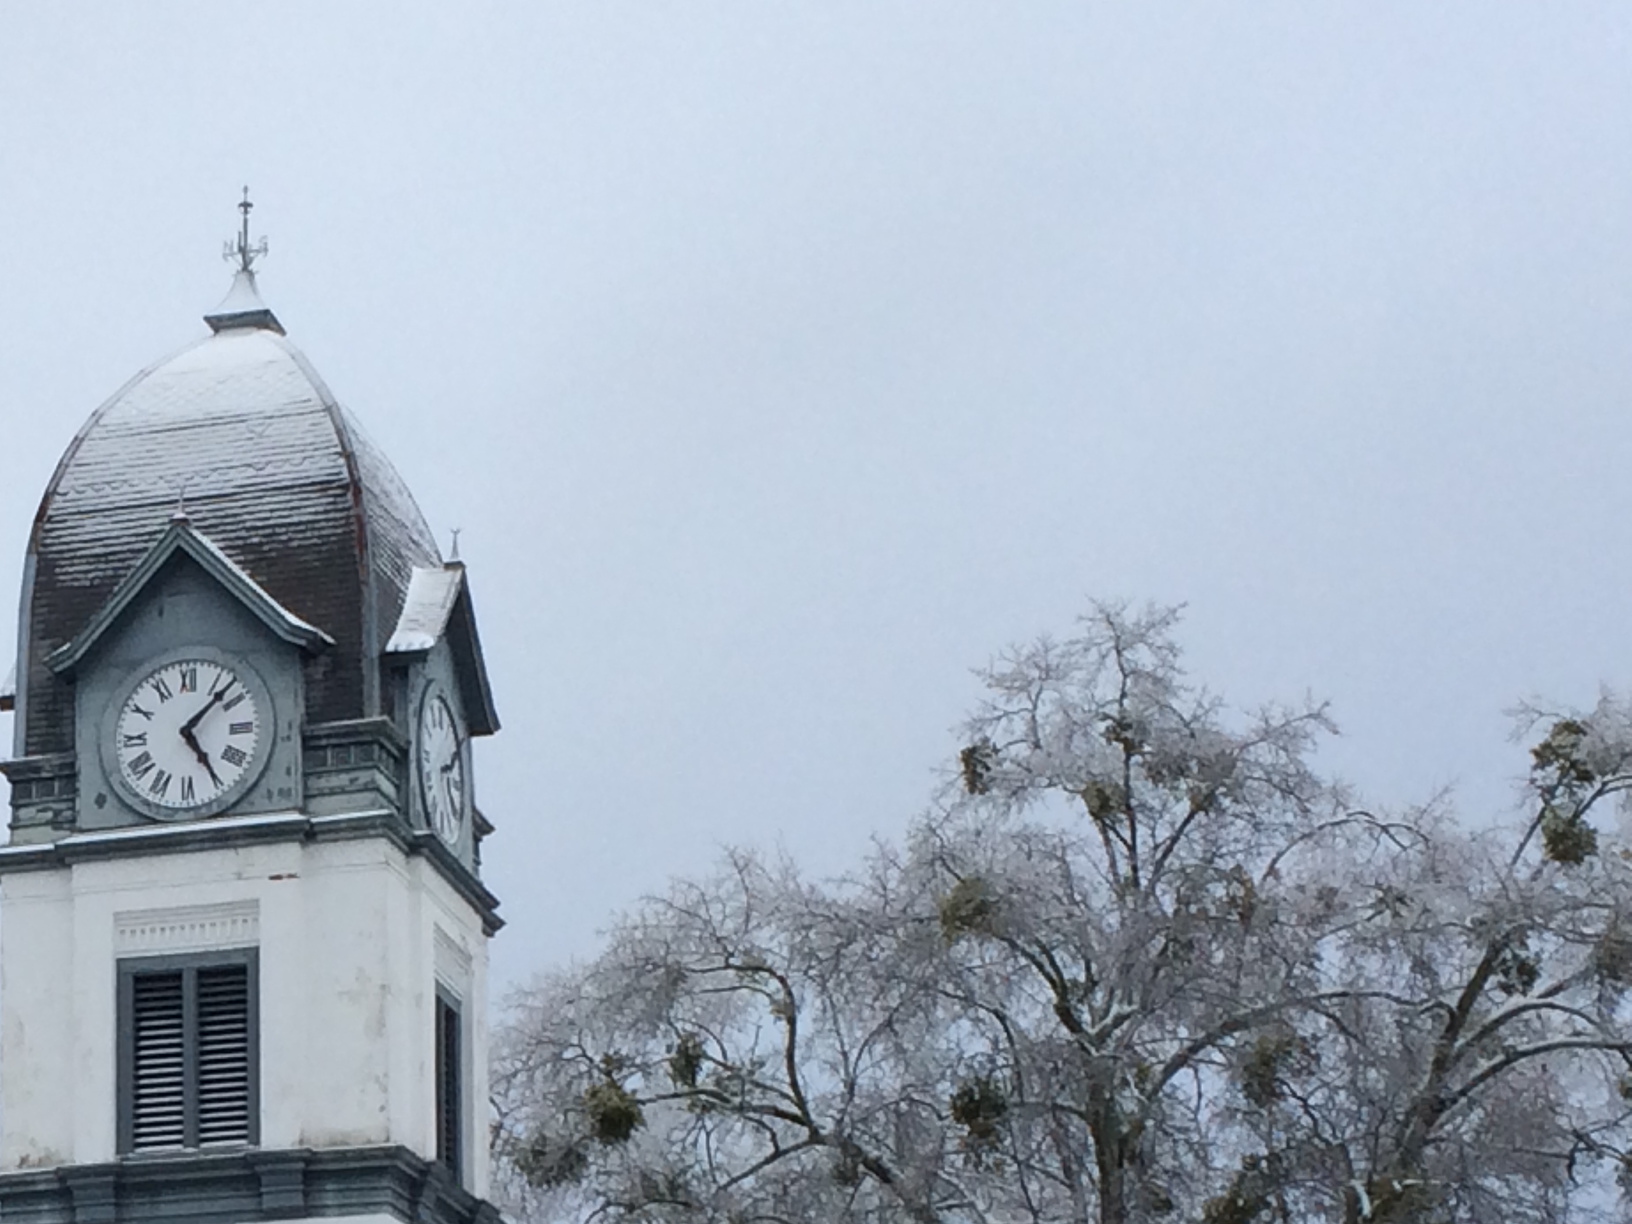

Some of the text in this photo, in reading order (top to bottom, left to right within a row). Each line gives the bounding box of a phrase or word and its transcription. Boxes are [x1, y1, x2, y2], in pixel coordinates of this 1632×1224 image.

[151, 677, 173, 704] XI
[180, 669, 197, 693] XII
[131, 703, 155, 721] X
[123, 731, 147, 748] IX
[181, 776, 195, 801] VI
